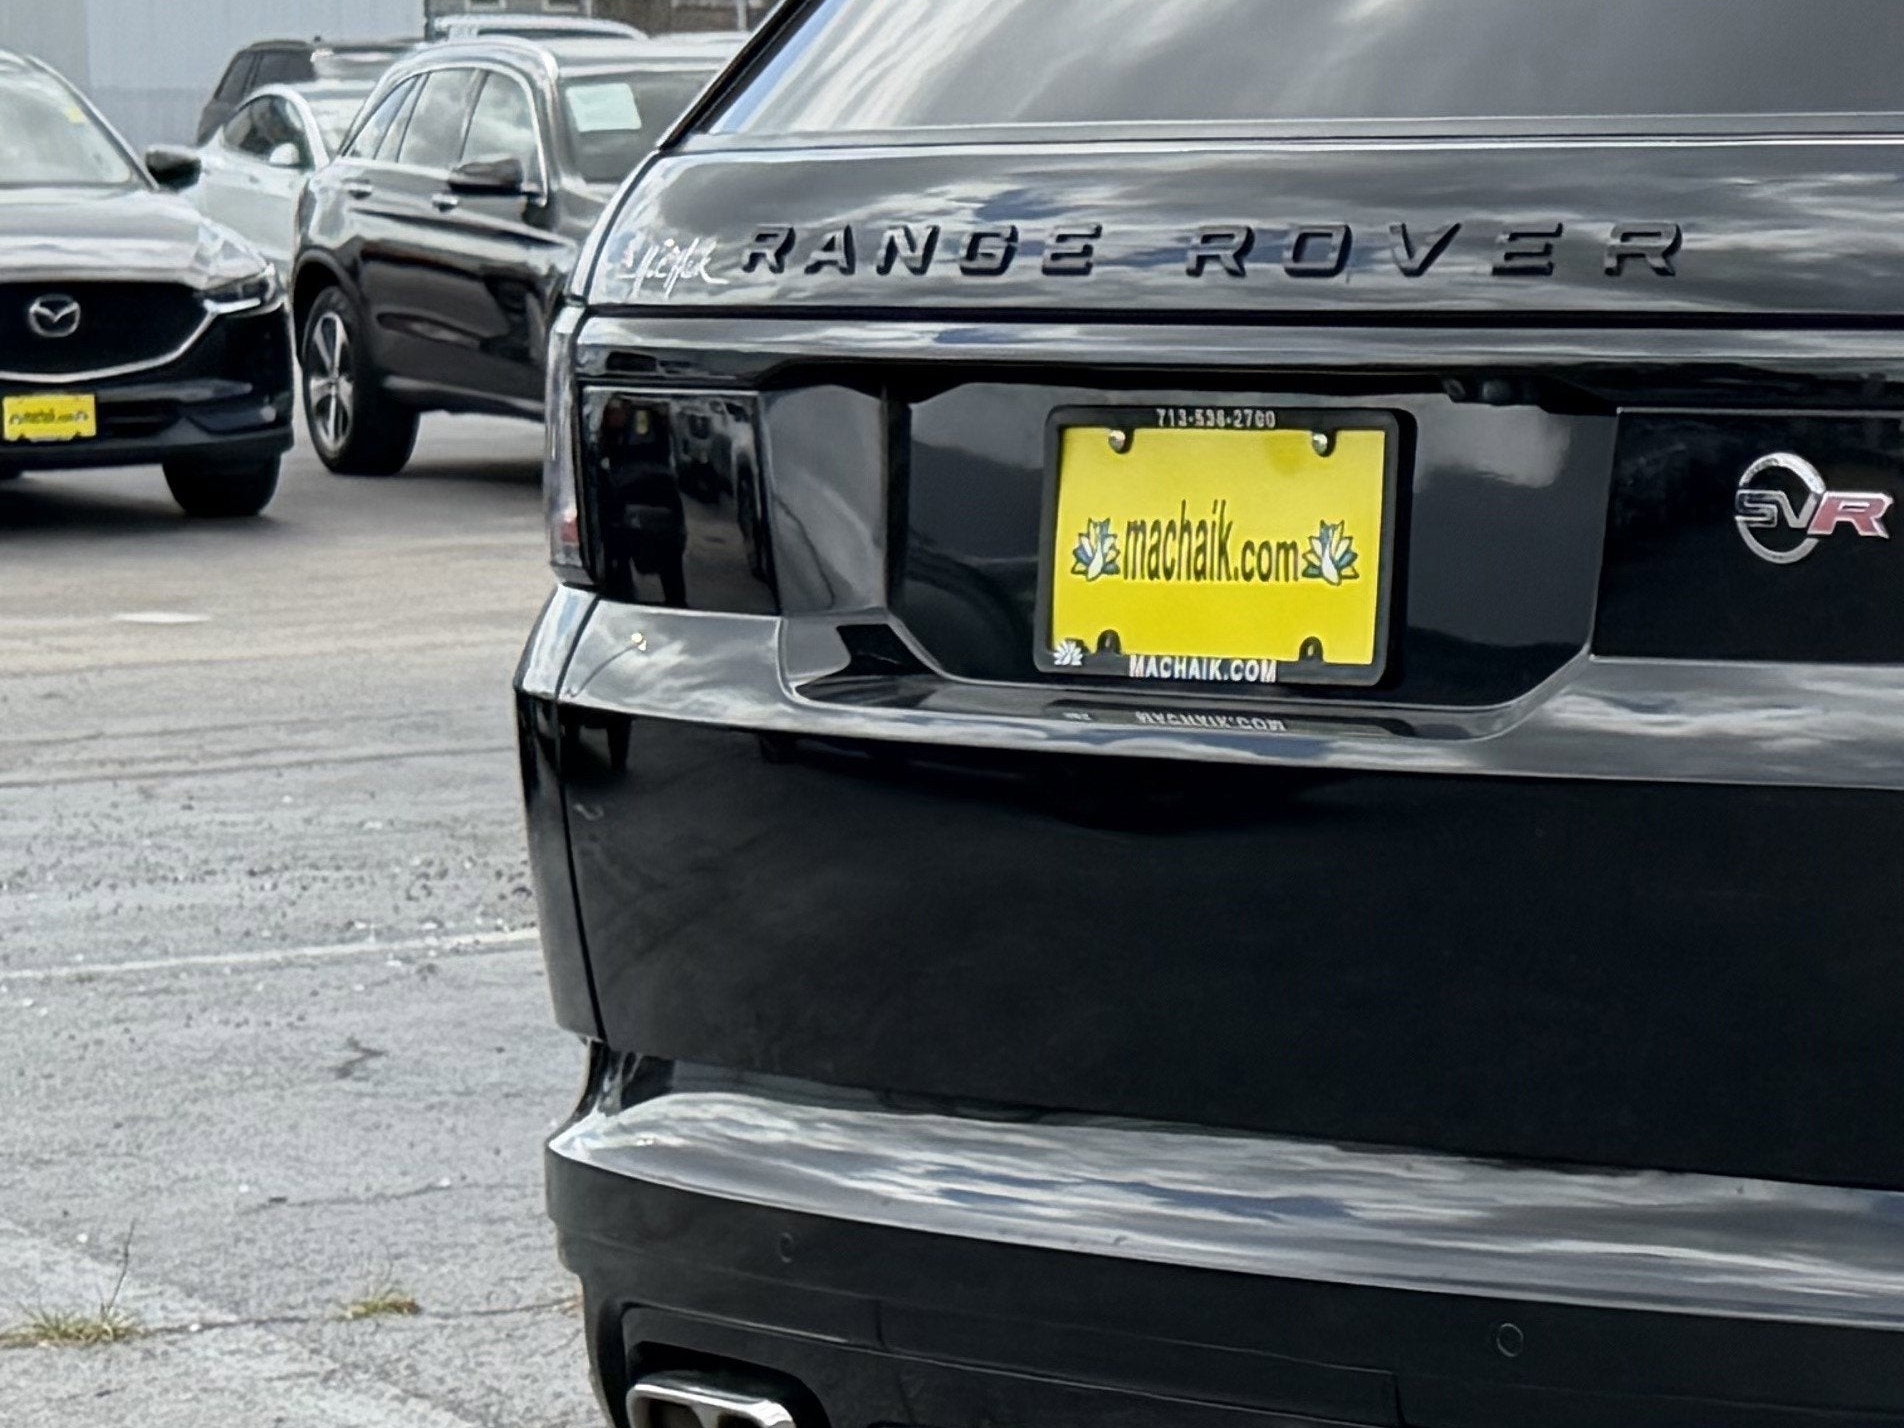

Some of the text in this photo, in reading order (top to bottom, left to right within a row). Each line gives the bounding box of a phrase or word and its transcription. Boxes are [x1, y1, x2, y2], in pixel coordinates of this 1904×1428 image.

[741, 223, 1102, 276] RANGE
[1185, 222, 1683, 278] ROVER
[1123, 498, 1299, 583] machaik.com
[1734, 489, 1895, 540] SVR
[1129, 654, 1278, 684] MACHAIK.COM
